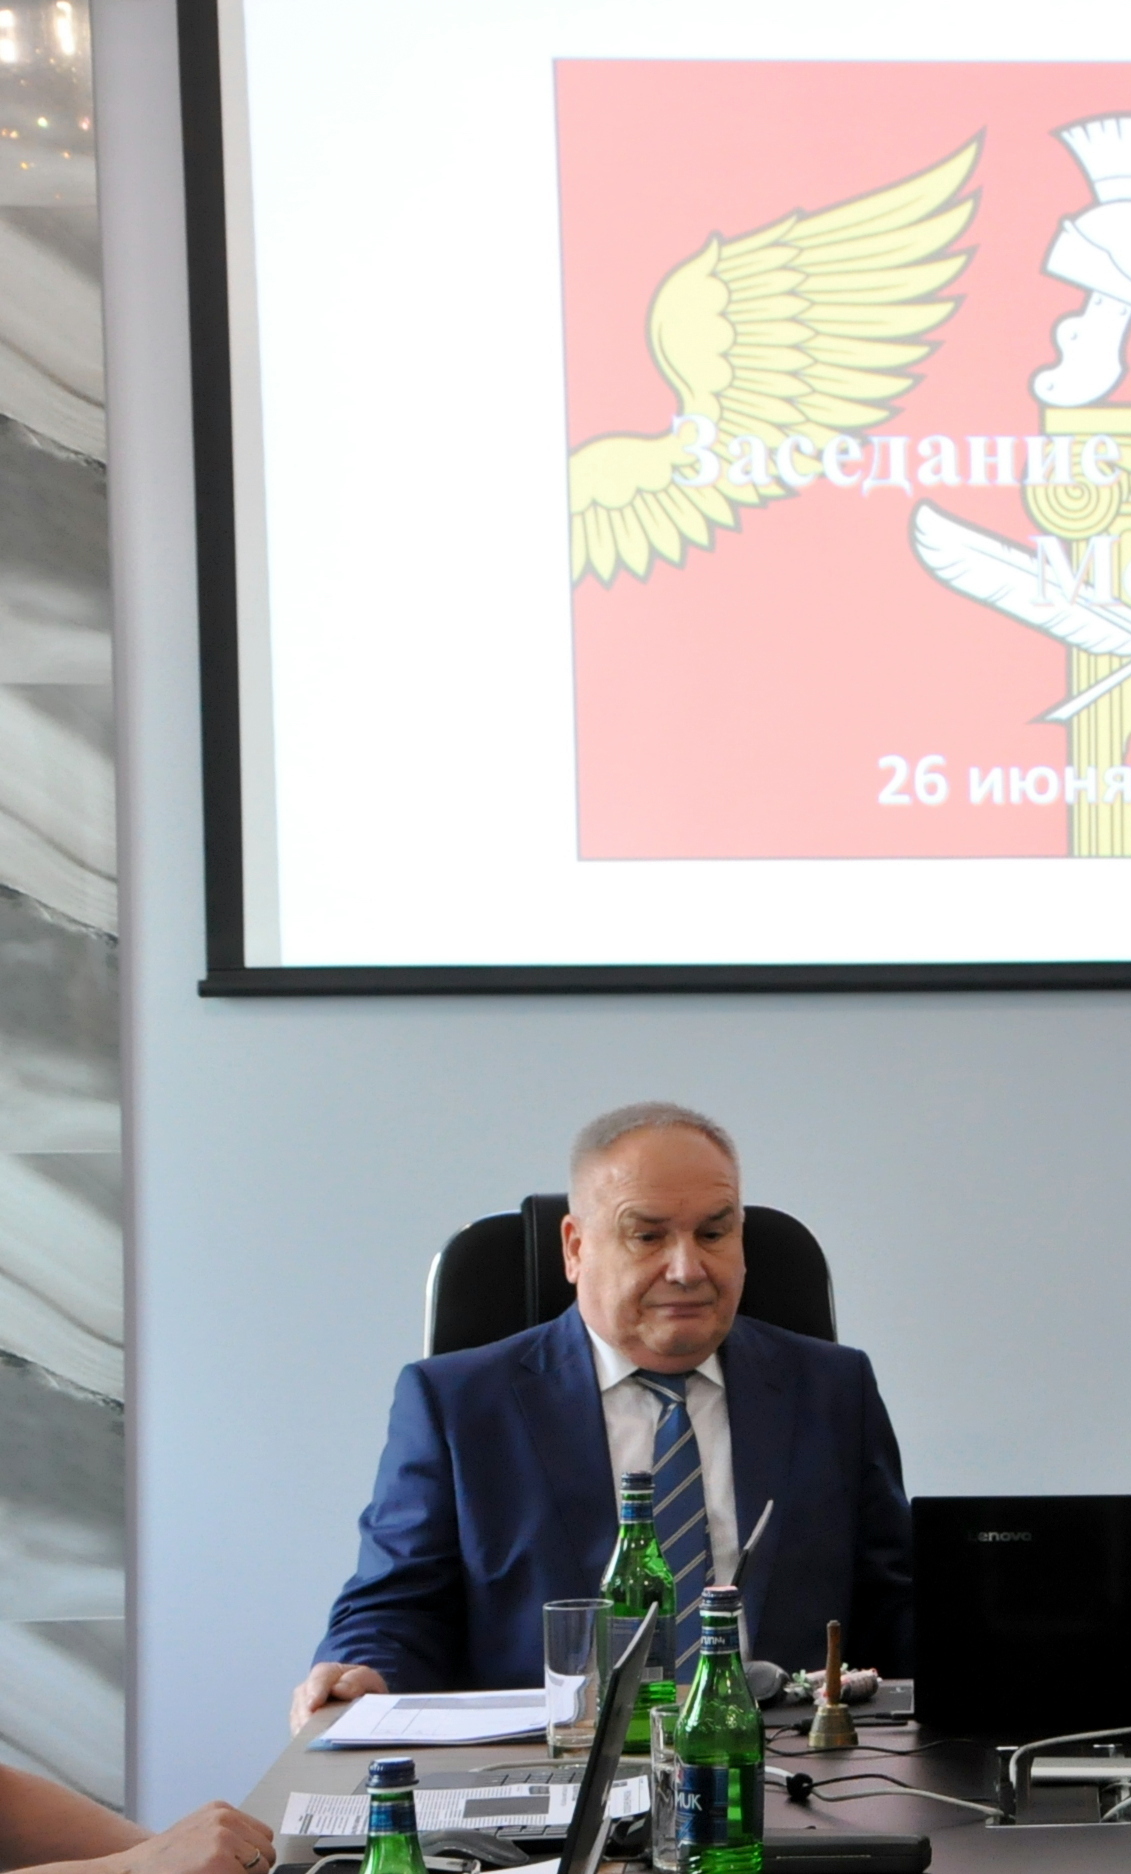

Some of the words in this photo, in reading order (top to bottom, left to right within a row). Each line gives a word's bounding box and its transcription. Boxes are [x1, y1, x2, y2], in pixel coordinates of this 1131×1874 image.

[672, 413, 1122, 497] Заседание
[876, 754, 950, 806] 26
[967, 1531, 1032, 1542] enovo
